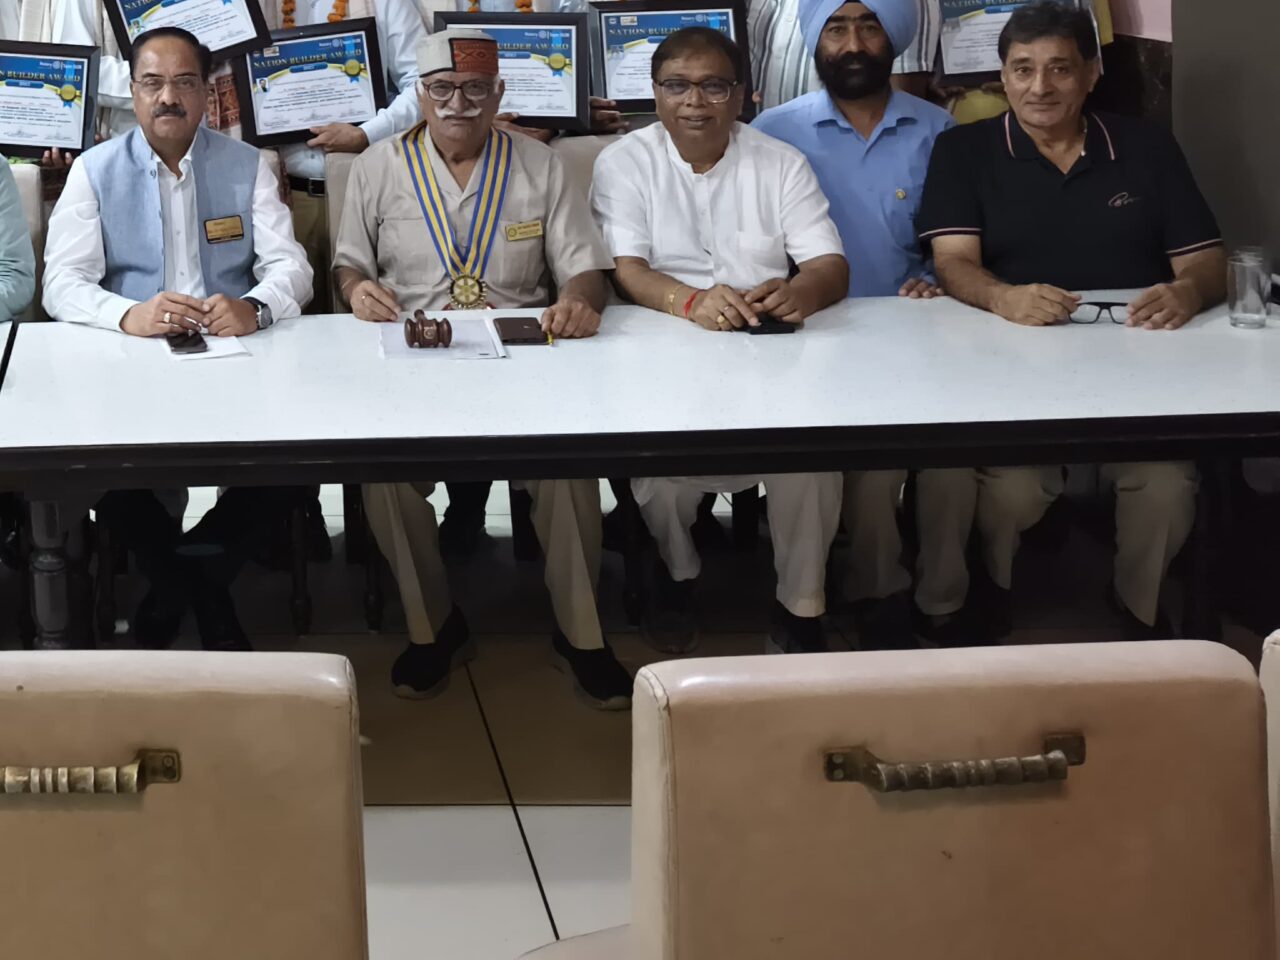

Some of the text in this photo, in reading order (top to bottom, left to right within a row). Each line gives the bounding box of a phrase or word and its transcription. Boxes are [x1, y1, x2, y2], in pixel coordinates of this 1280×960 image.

[943, 0, 982, 7] NATION
[254, 49, 361, 68] NATION BUILDER AWARD
[7, 71, 45, 79] BUILDER
